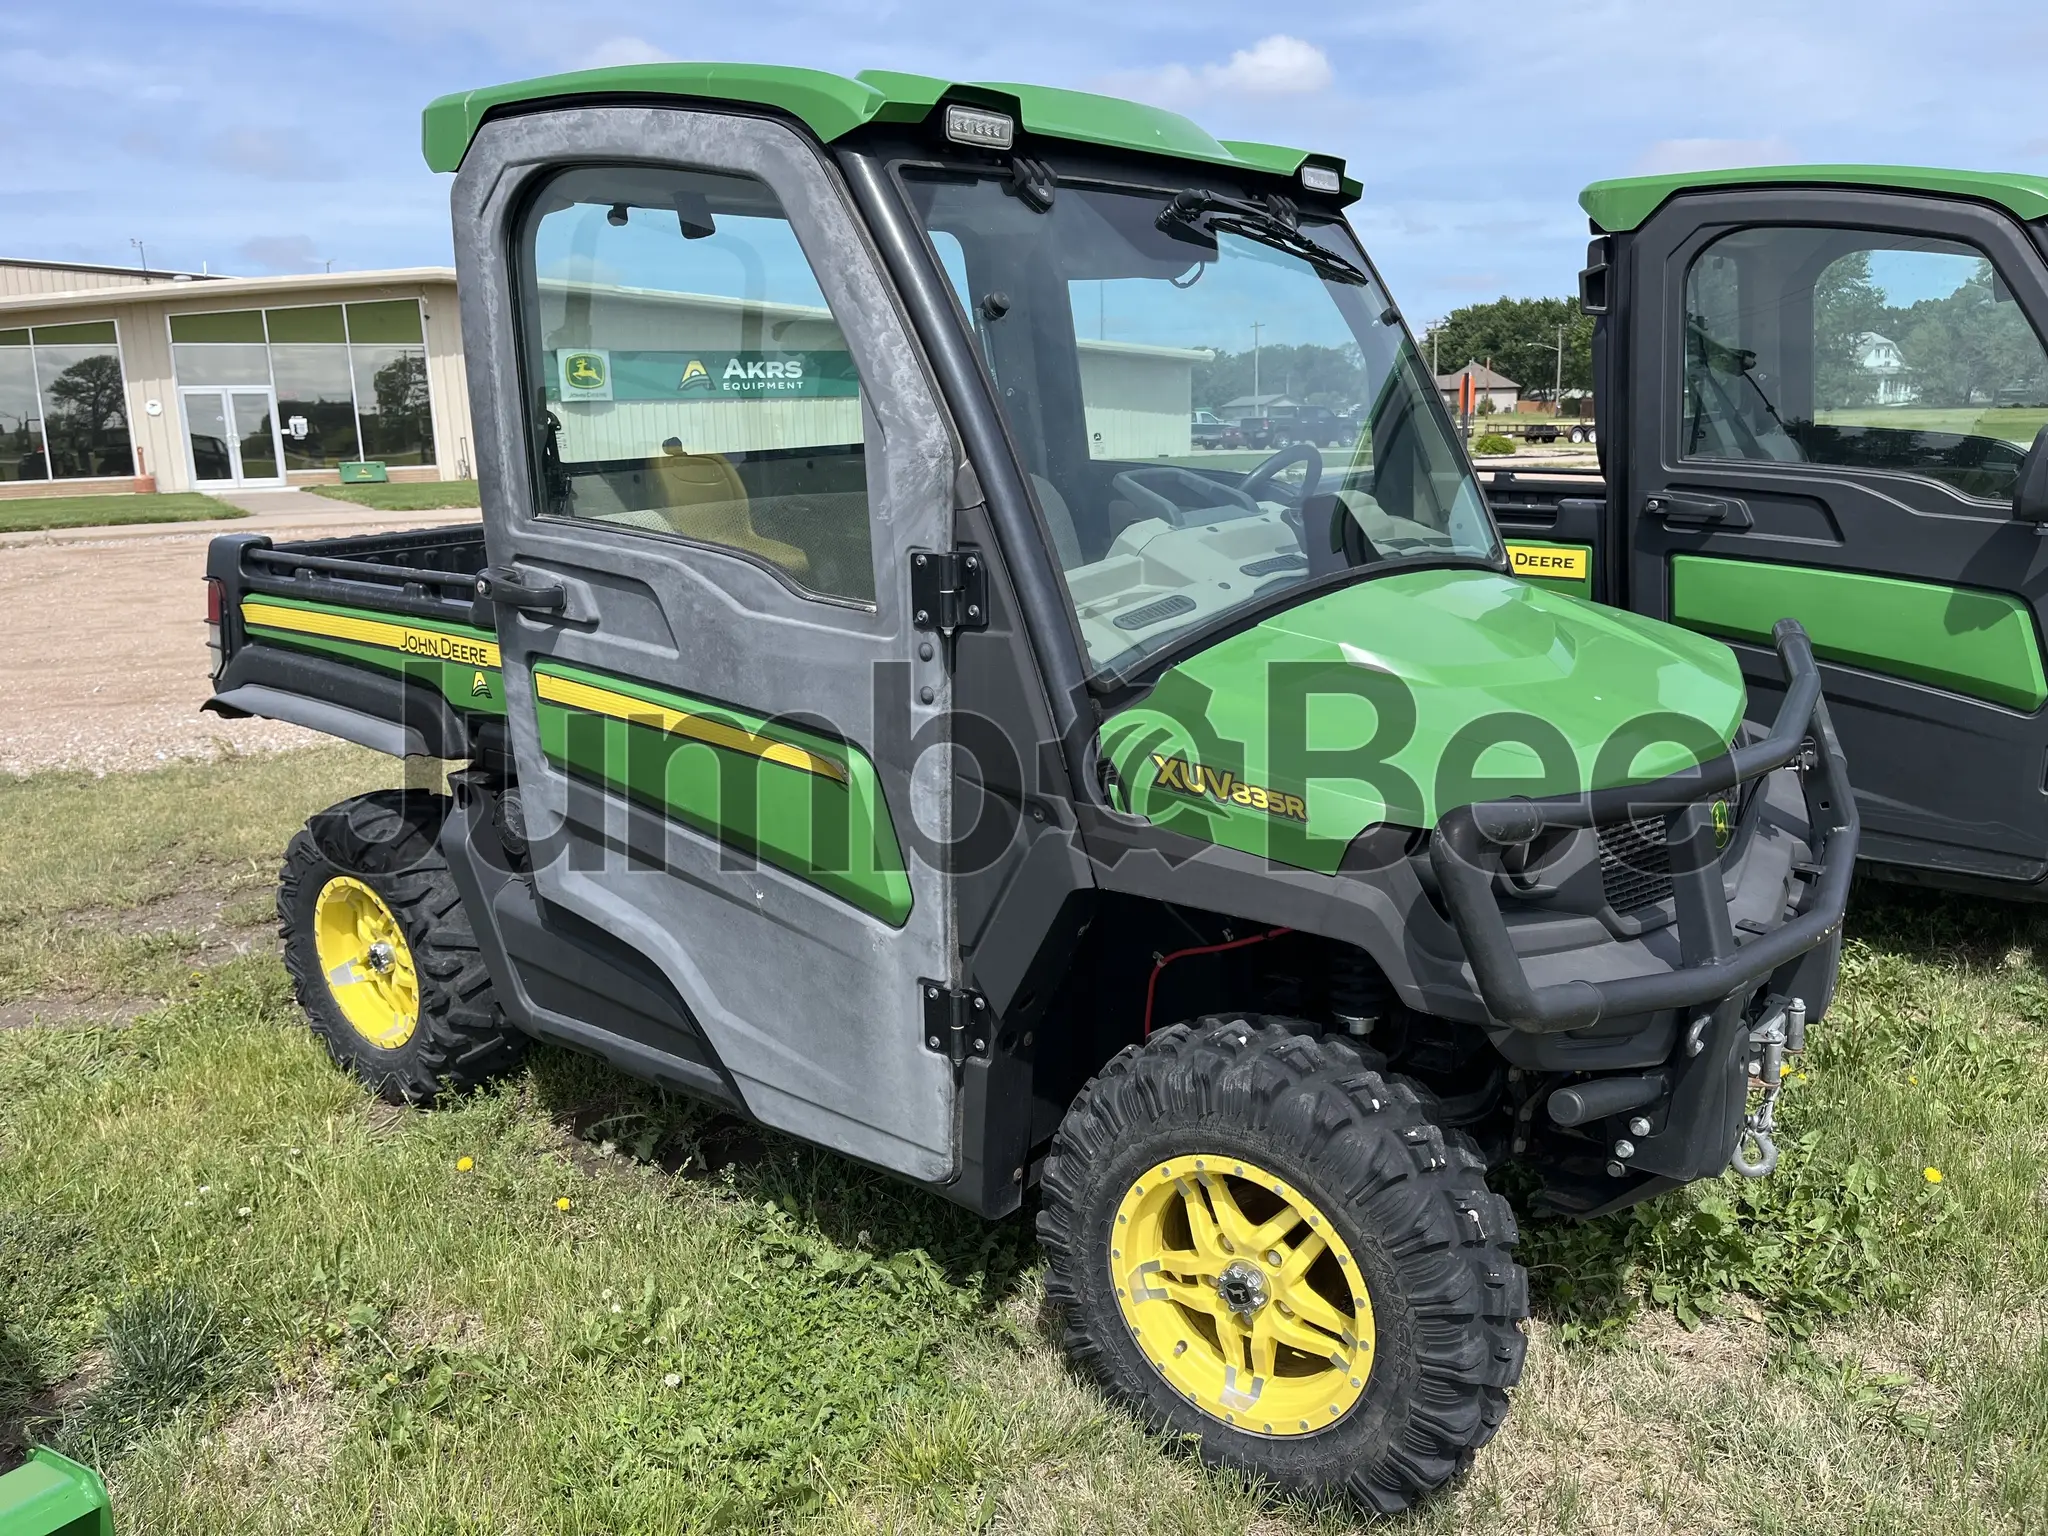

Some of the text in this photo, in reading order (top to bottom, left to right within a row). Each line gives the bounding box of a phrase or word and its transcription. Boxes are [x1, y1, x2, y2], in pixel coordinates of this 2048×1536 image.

[722, 358, 803, 379] AKRS
[722, 381, 804, 391] EQUIPMENT
[1515, 552, 1575, 569] DEERE
[400, 631, 488, 665] JOHN DEERE
